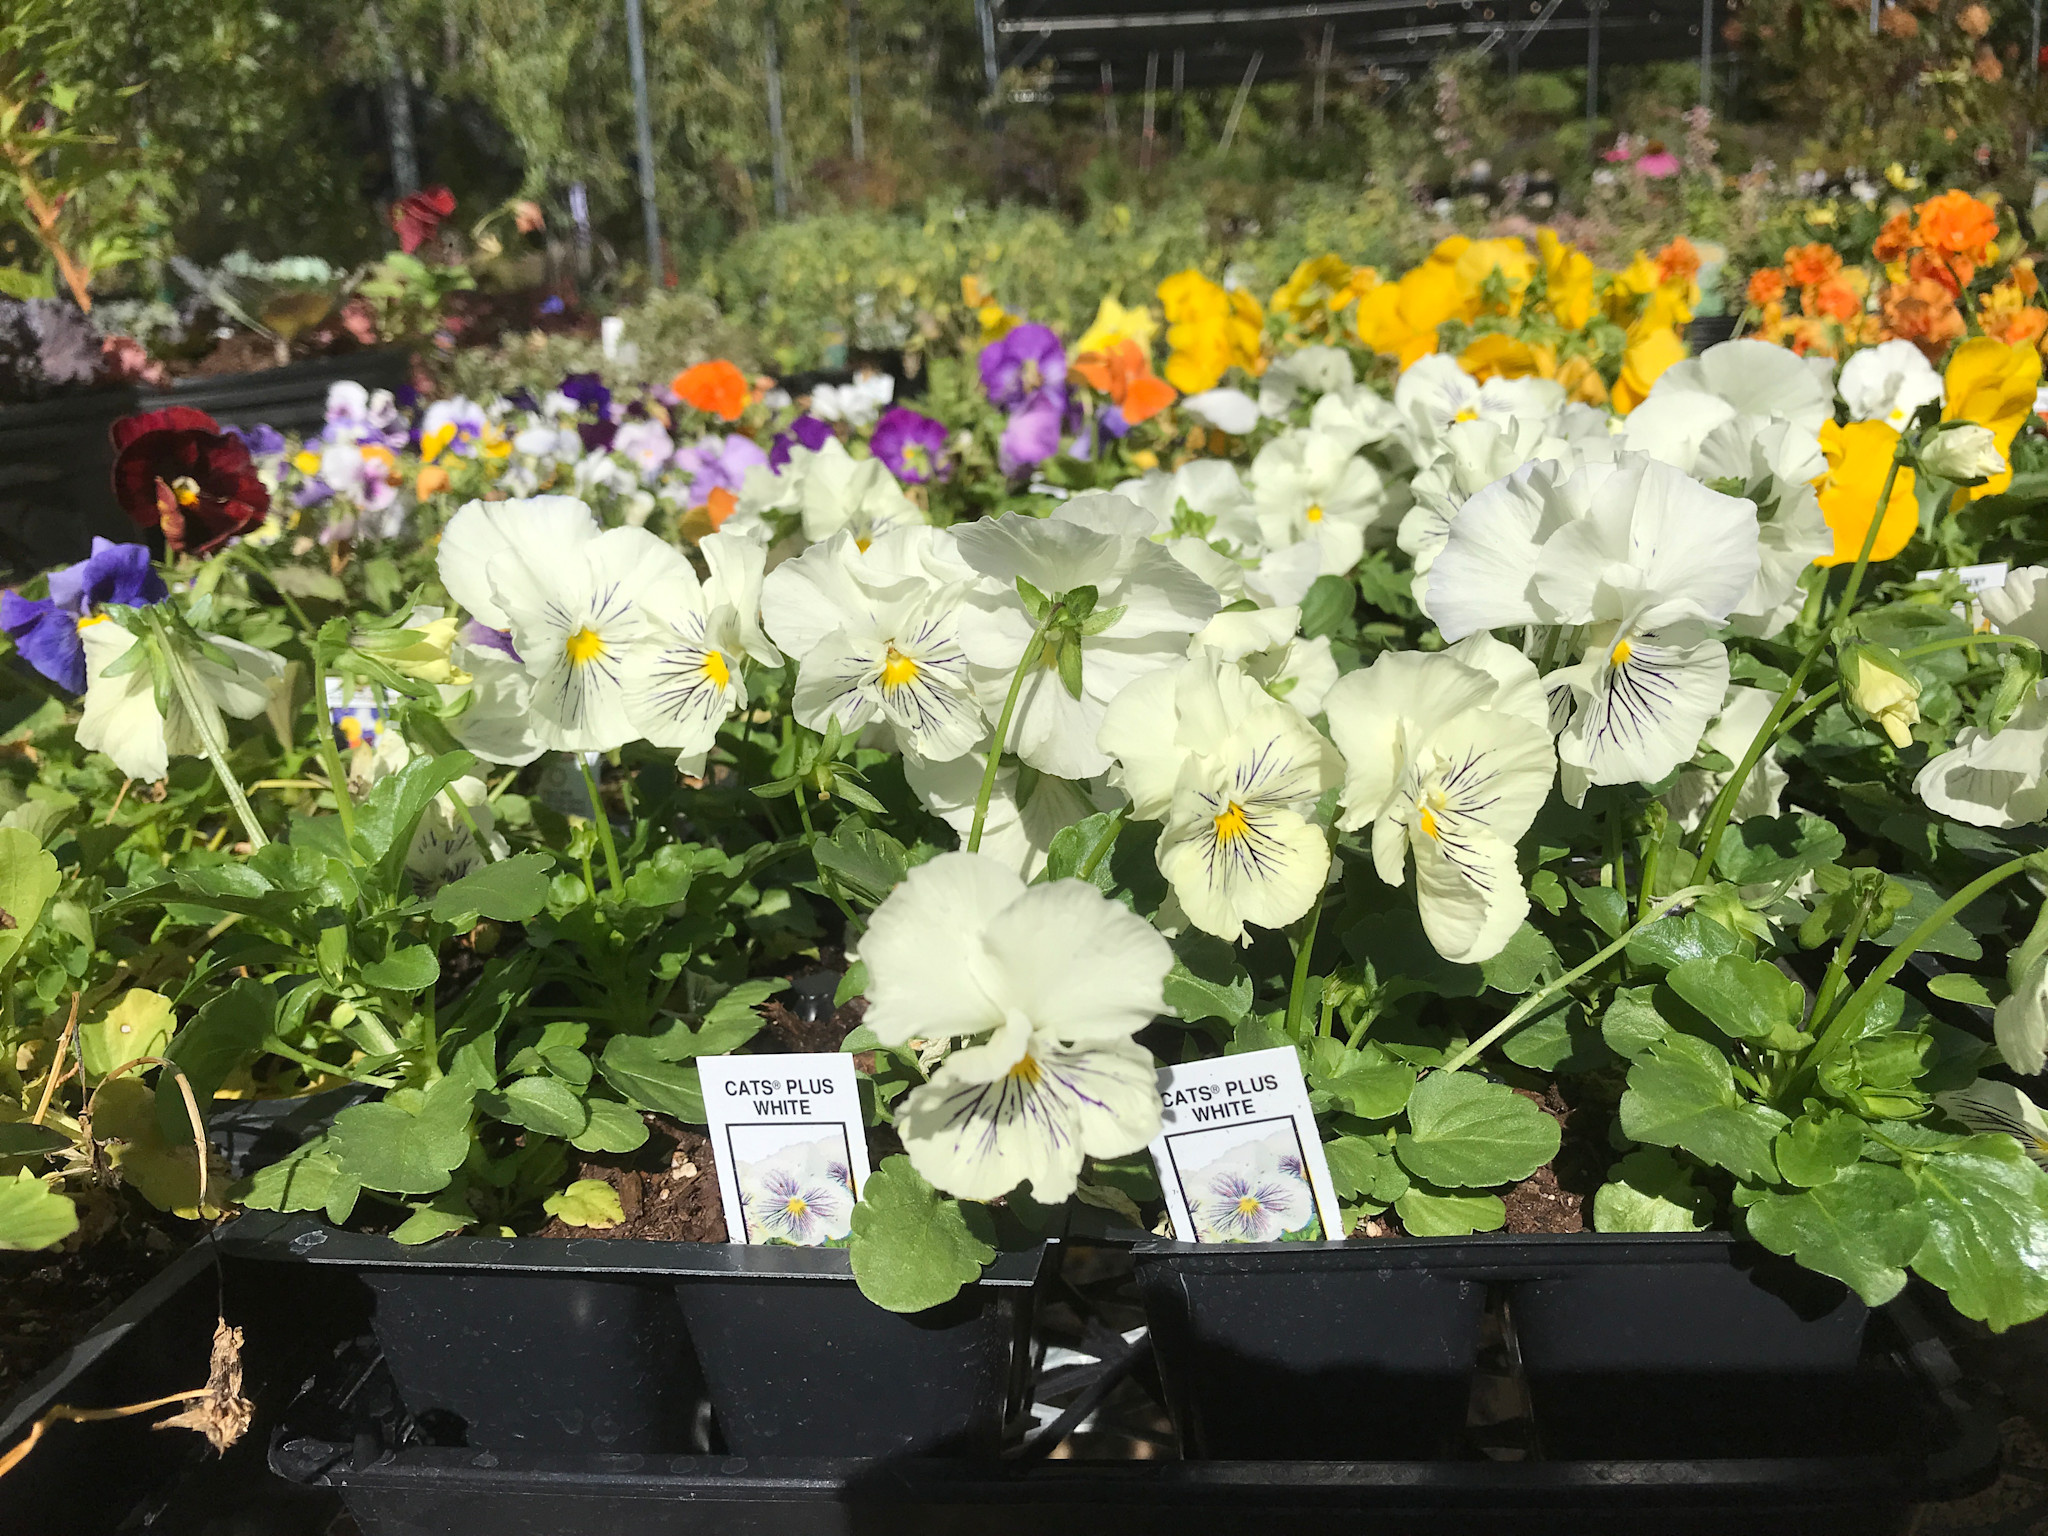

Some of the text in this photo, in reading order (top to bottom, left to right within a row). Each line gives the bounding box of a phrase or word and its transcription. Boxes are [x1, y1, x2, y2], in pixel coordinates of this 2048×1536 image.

[786, 1078, 835, 1095] PLUS
[1225, 1075, 1278, 1097] PLUS
[753, 1099, 812, 1116] WHITE
[1192, 1098, 1256, 1122] WHITE
